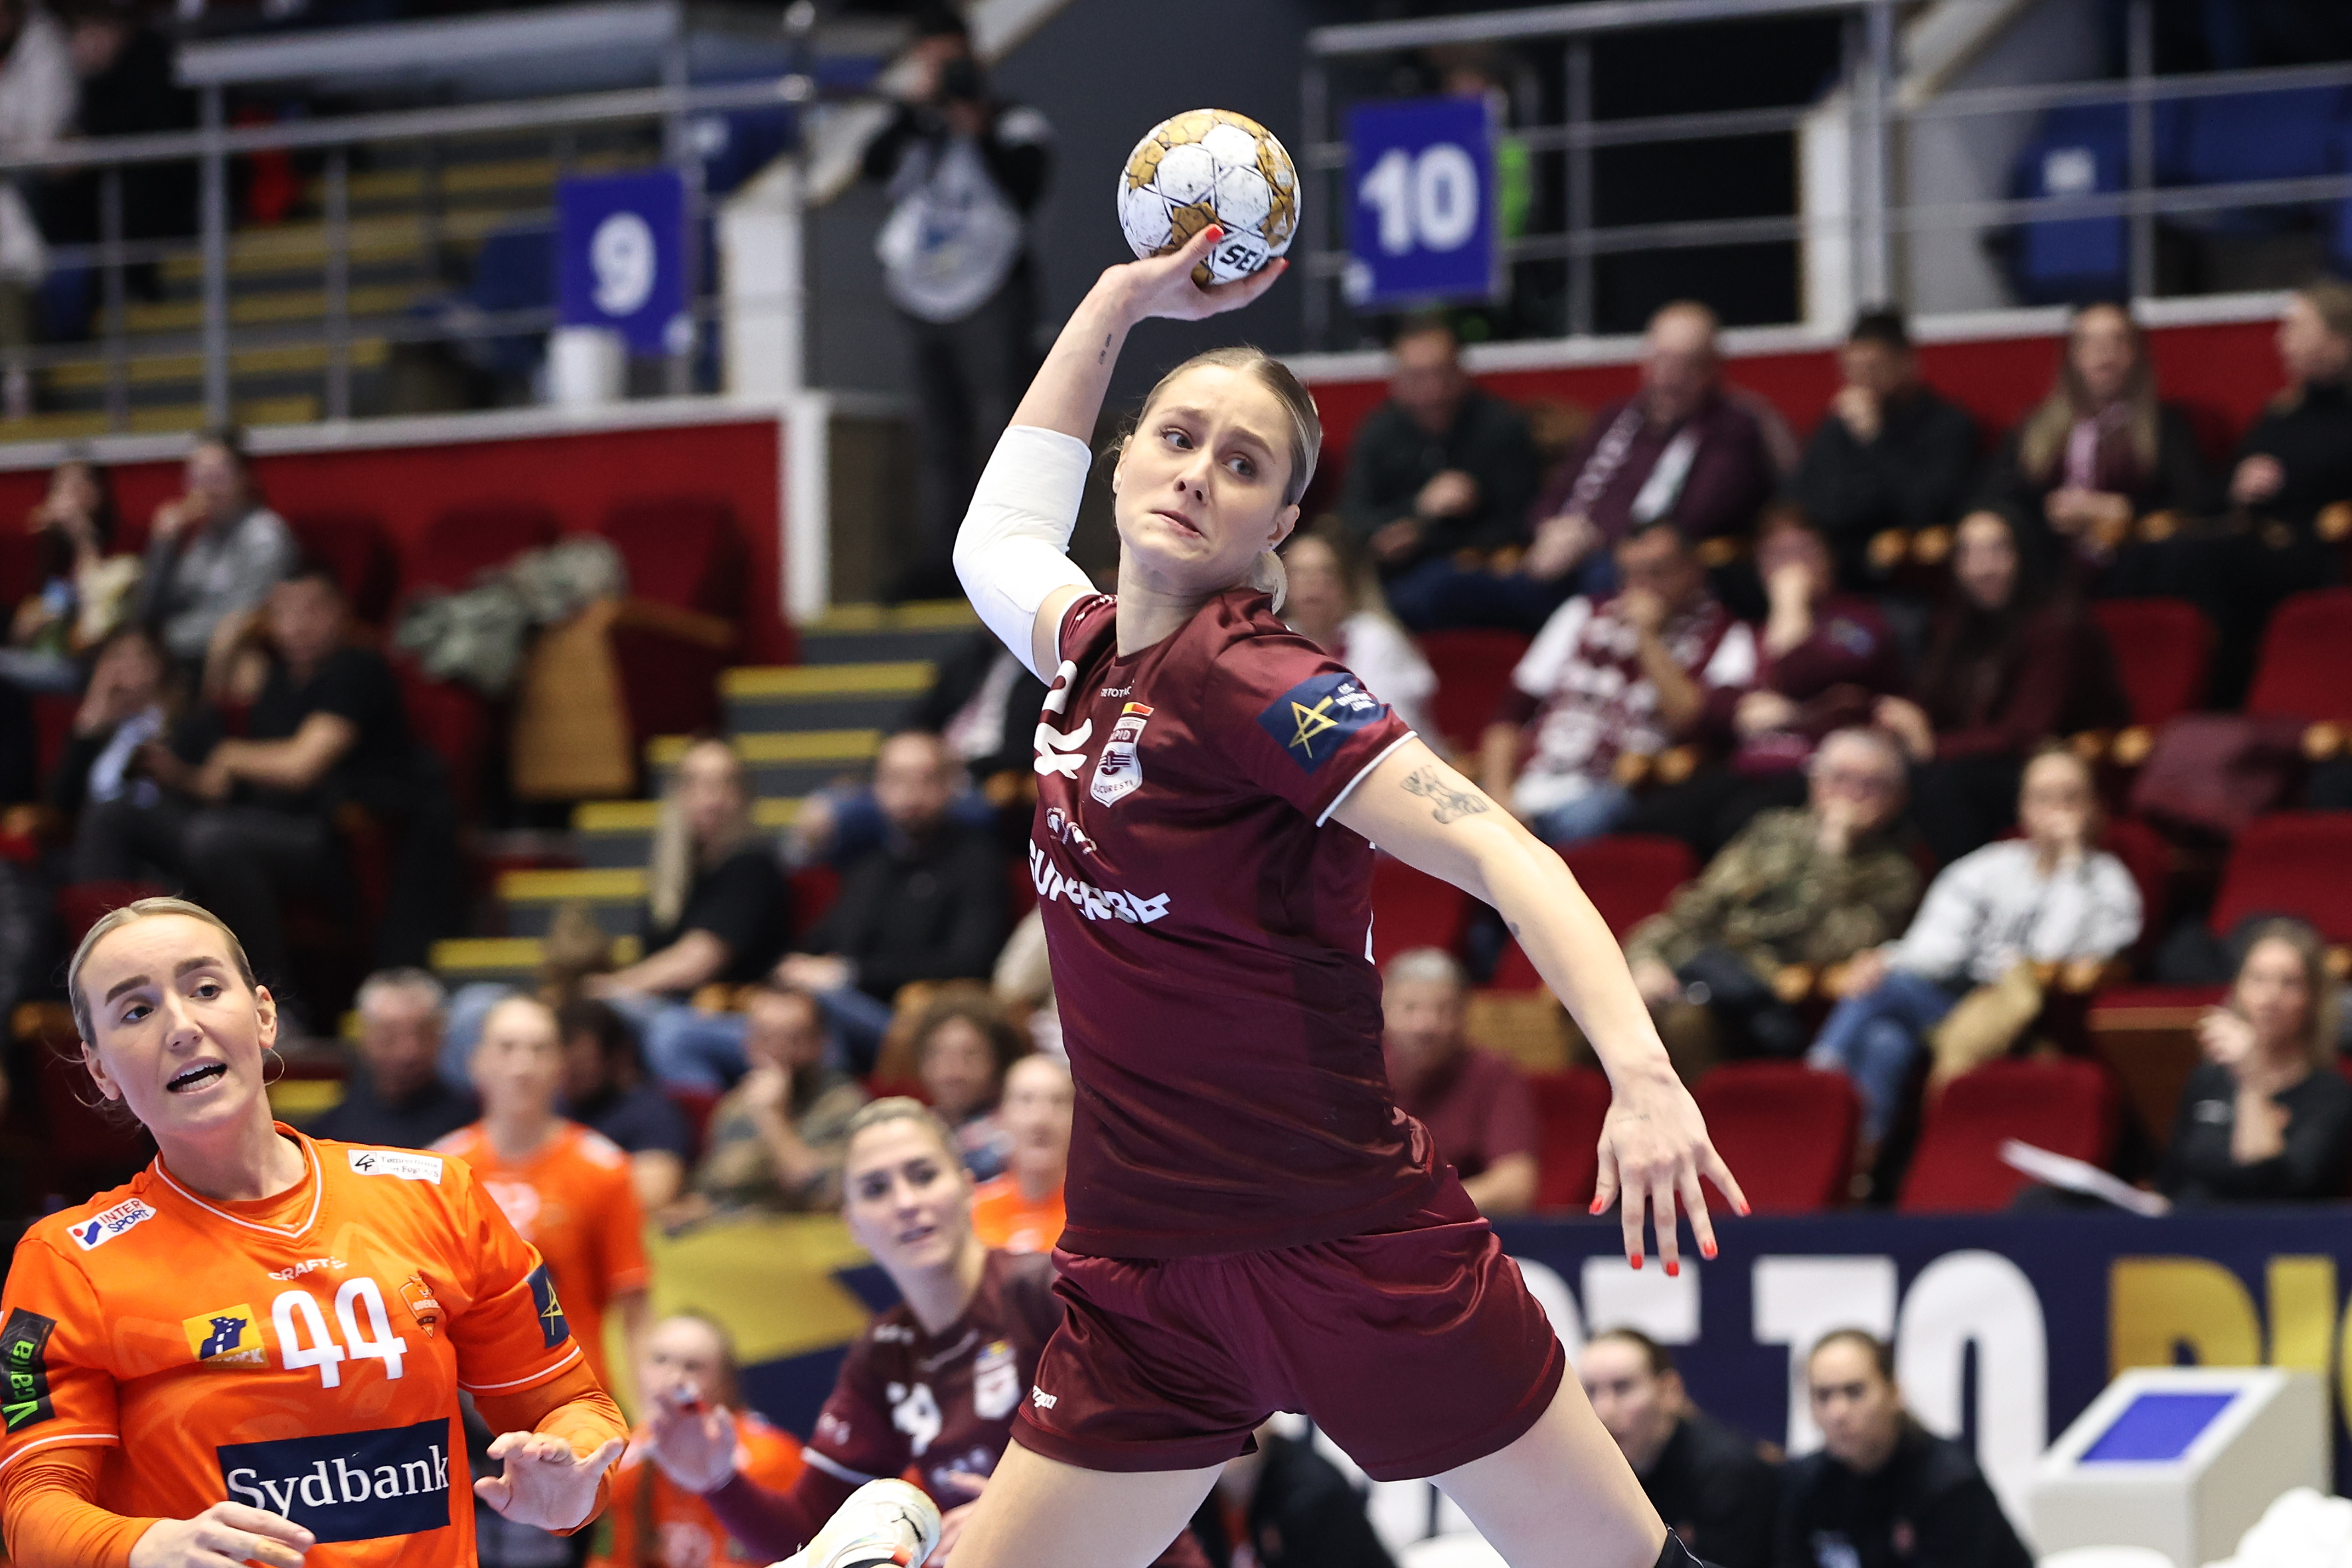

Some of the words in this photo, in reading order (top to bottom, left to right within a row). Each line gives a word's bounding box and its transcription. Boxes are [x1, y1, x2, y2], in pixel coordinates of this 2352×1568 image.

[1358, 142, 1481, 255] 10
[589, 210, 658, 316] 9
[99, 1200, 143, 1223] INTER
[108, 1209, 149, 1233] SPORT
[268, 1257, 331, 1281] CRAFT
[272, 1277, 408, 1389] 44
[227, 1444, 450, 1520] Sydbank
